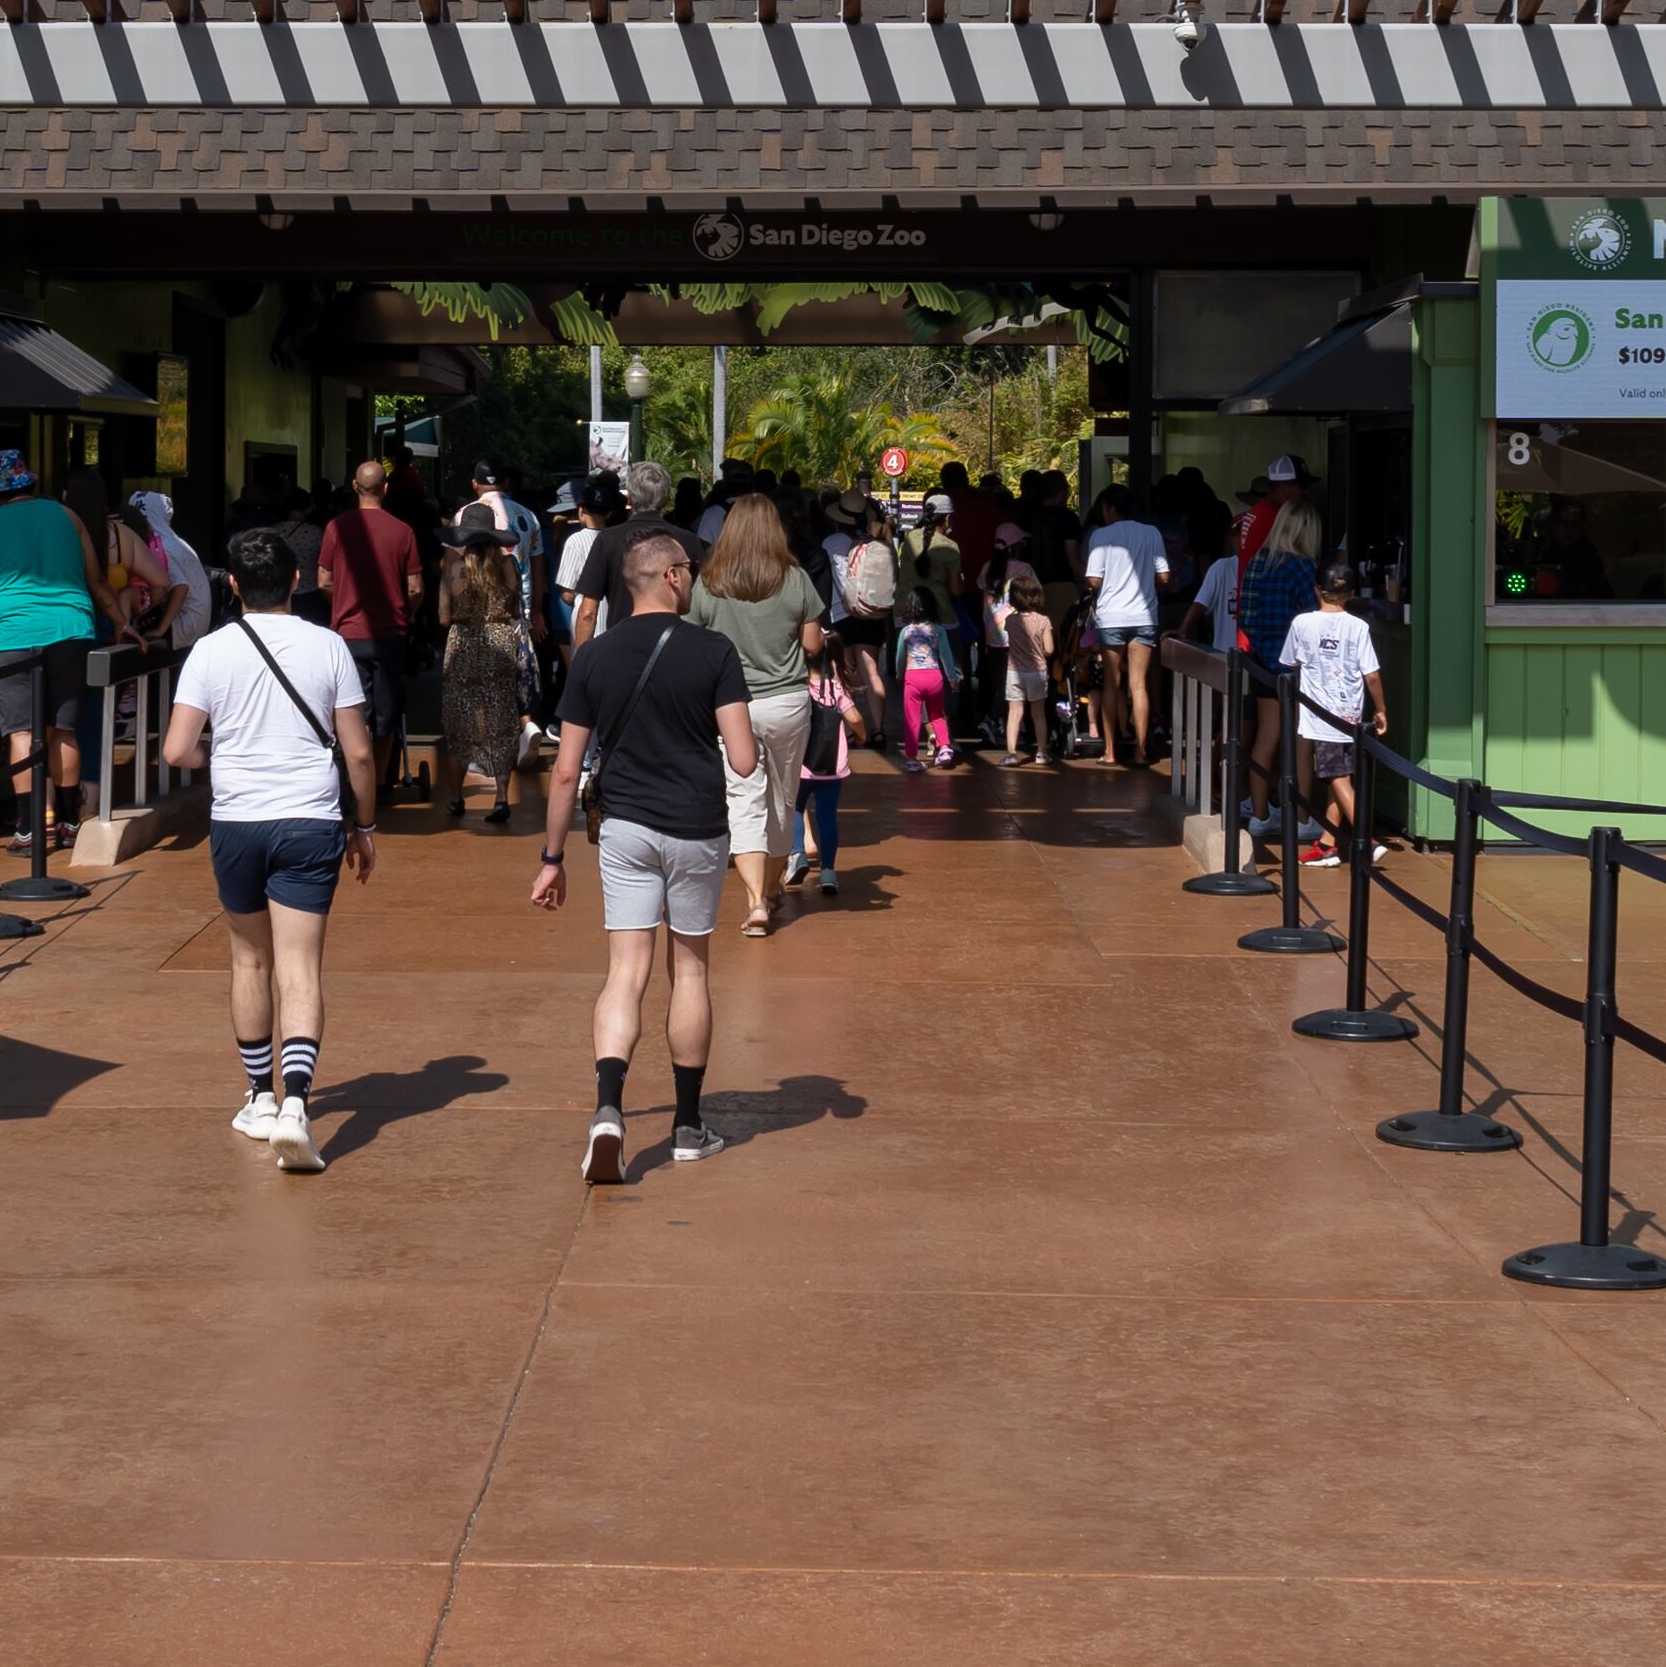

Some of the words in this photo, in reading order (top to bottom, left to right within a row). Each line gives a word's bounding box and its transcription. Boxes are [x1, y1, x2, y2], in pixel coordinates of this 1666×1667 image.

[460, 222, 589, 247] Welcome
[600, 225, 629, 247] to
[637, 222, 685, 247] the
[749, 223, 796, 246] San
[801, 223, 874, 252] Diego
[876, 224, 927, 246] Zoo
[1614, 307, 1664, 330] San
[1618, 346, 1666, 365] $109
[1619, 387, 1647, 399] Valid
[1508, 433, 1531, 466] 8
[887, 455, 899, 469] 4
